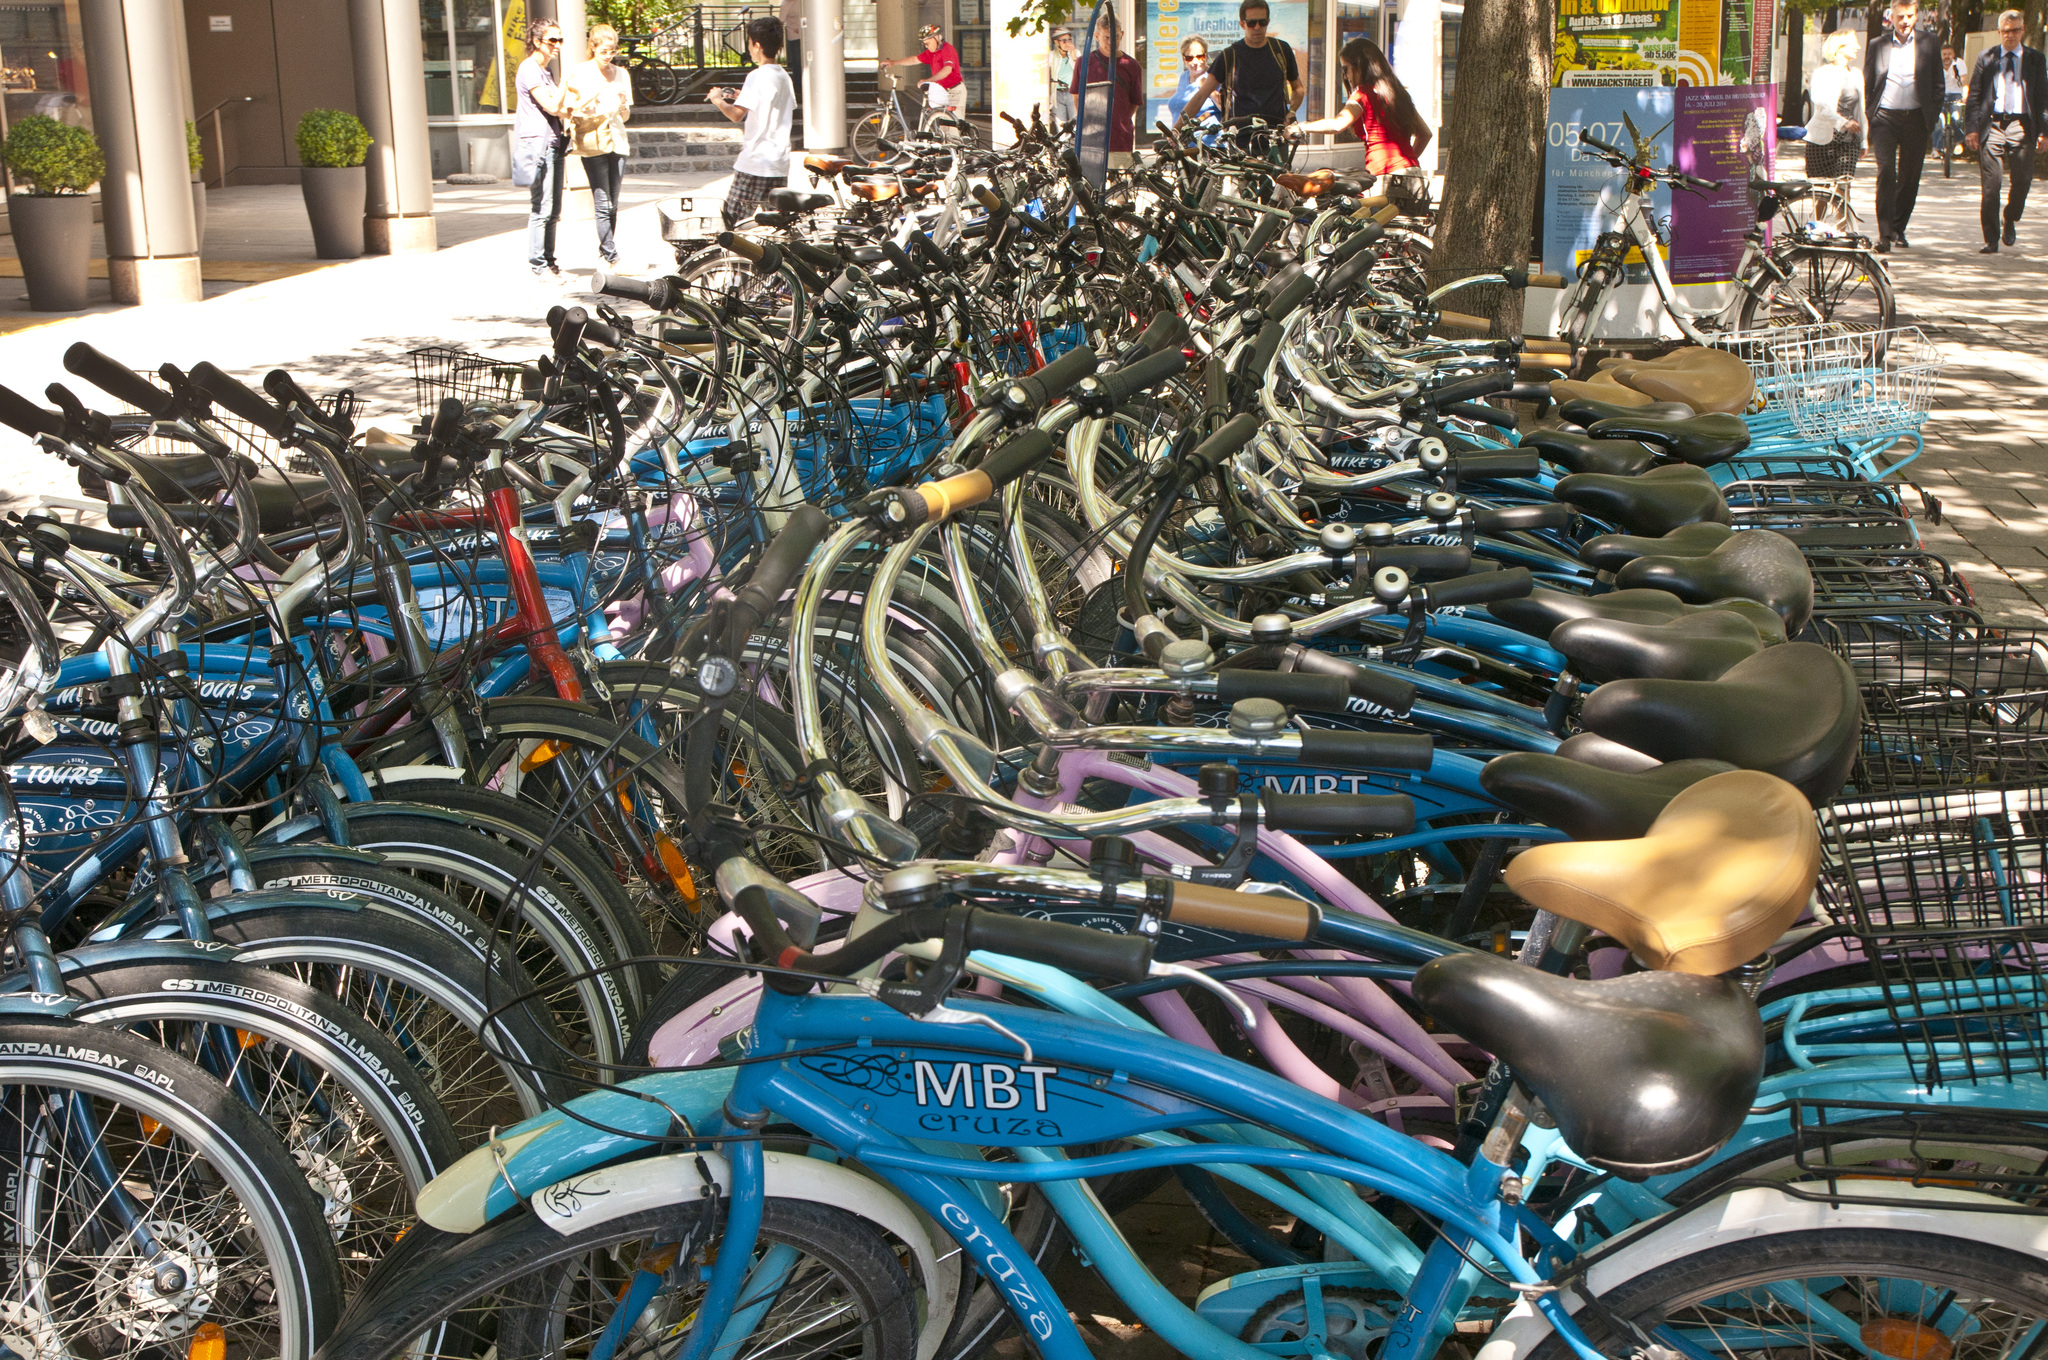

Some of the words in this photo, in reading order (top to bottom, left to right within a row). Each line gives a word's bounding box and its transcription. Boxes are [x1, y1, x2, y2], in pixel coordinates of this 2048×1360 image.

[1569, 16, 1584, 27] Auf
[1585, 15, 1599, 26] bis
[1600, 15, 1612, 25] zu
[1612, 13, 1623, 25] 10
[1624, 13, 1652, 24] Areas
[1653, 13, 1661, 22] &
[1572, 78, 1653, 87] WWW.BACKSTAGE.EU
[1551, 168, 1565, 177] für
[1570, 168, 1613, 178] München
[1331, 456, 1381, 468] MIKE'S
[1427, 534, 1462, 548] TOU
[434, 594, 508, 625] MBT
[194, 681, 256, 701] TOURS
[27, 765, 104, 786] TOURS
[263, 876, 302, 890] CST
[300, 875, 408, 900] METROPOLITAN
[402, 893, 474, 937] PALMBAY
[1092, 917, 1111, 926] BIKE
[1111, 919, 1129, 936] TOUR
[536, 886, 563, 914] CST
[561, 908, 620, 1001] METROPOLTAN
[161, 979, 209, 992] CST
[207, 981, 332, 1033] METROPOLITAN
[324, 1023, 400, 1087] PALMBAY
[23, 1043, 129, 1070] PALMBAY
[143, 1069, 175, 1093] APL
[914, 1060, 1058, 1112] MBT
[918, 1113, 1063, 1138] cruza
[941, 1203, 1053, 1341] cruza
